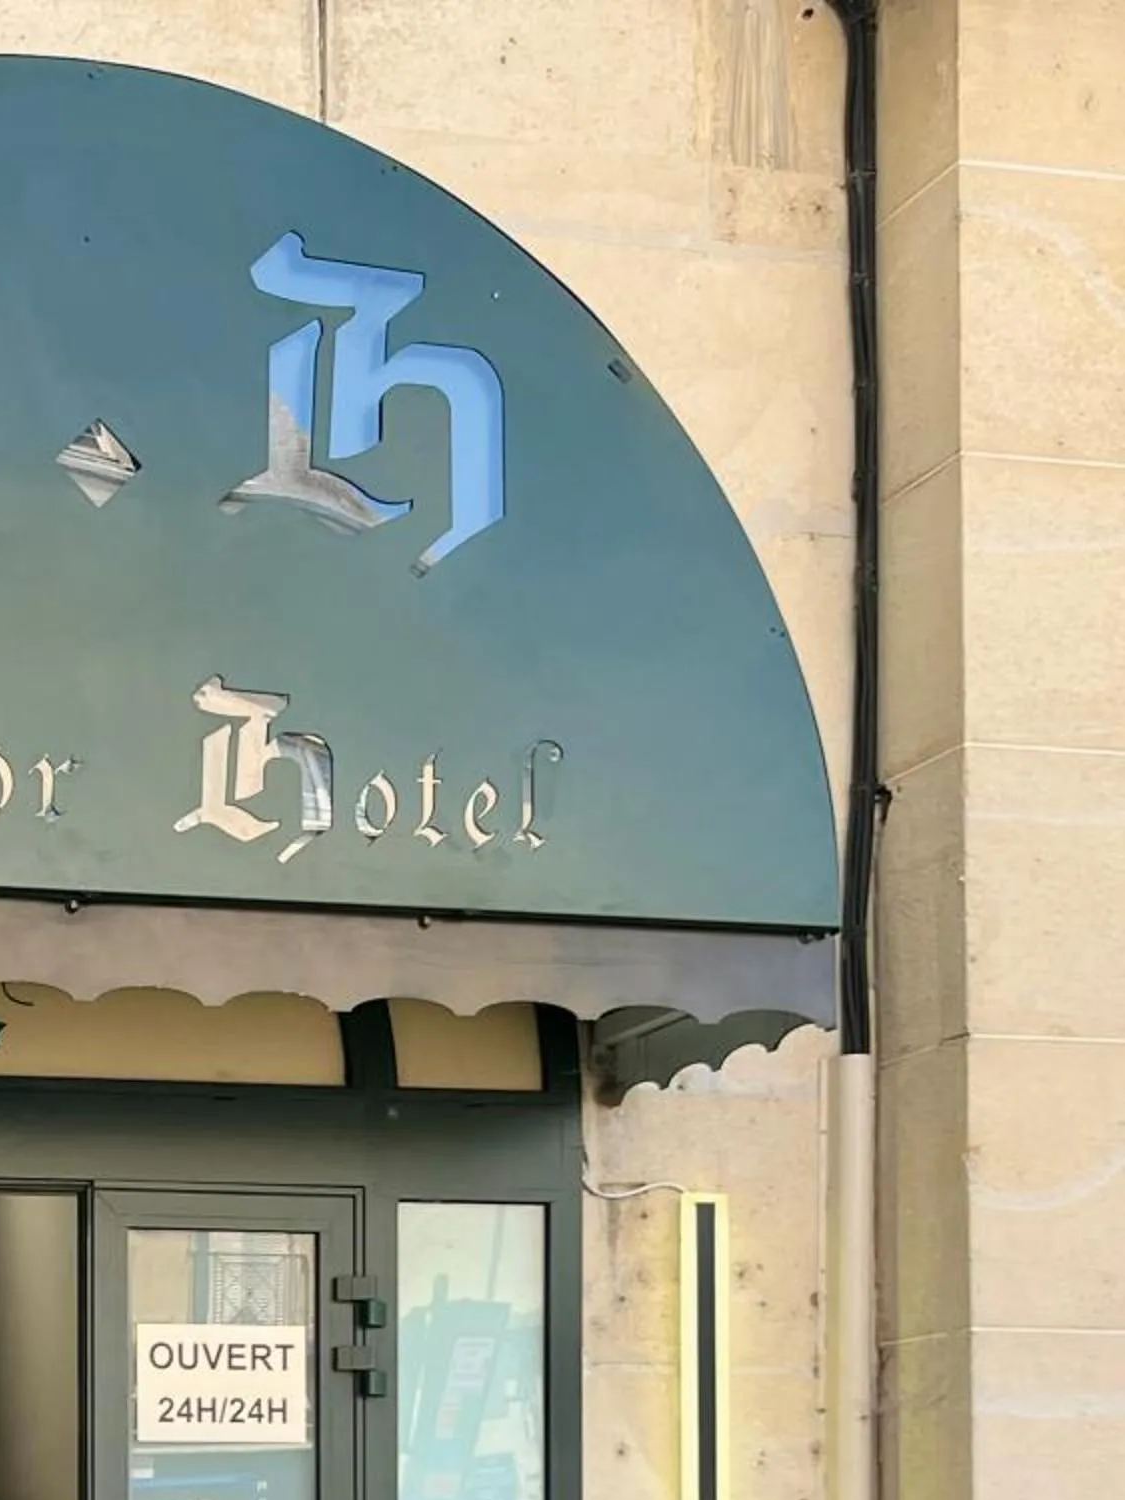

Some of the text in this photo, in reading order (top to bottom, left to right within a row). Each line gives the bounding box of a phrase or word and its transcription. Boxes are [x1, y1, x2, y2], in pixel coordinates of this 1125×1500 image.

[172, 672, 565, 865] Hotel
[149, 1341, 295, 1371] OUVERT
[157, 1396, 288, 1425] 24H/24H
